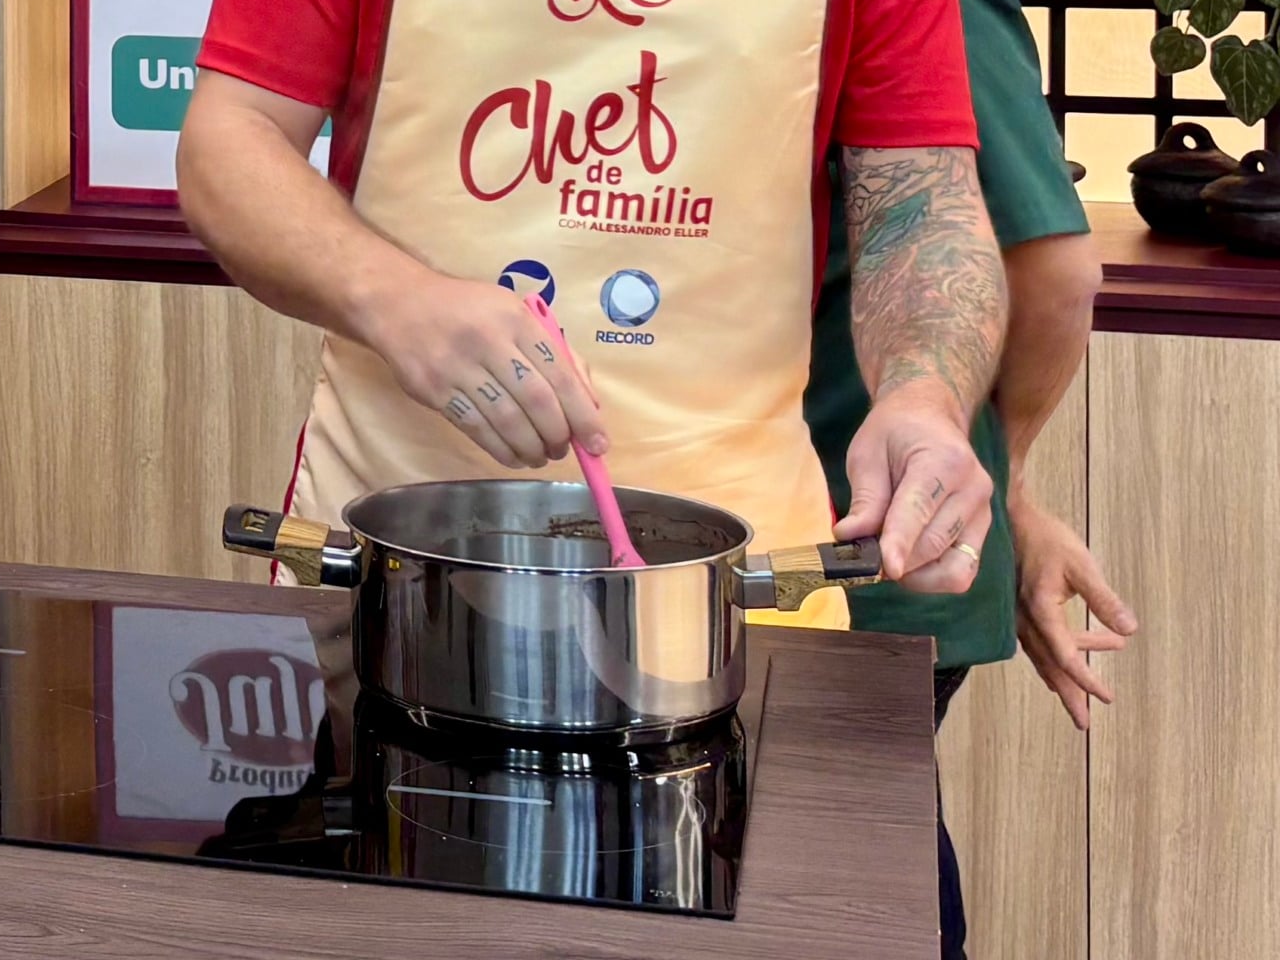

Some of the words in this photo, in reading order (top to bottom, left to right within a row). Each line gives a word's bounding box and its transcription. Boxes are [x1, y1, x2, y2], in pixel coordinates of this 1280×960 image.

[138, 58, 199, 89] Un
[460, 50, 677, 201] Chef
[586, 159, 622, 185] de
[559, 179, 713, 225] família
[558, 218, 587, 230] COM
[589, 221, 671, 236] ALESSANDRO
[673, 227, 709, 238] ELLER
[595, 330, 655, 345] RECORD
